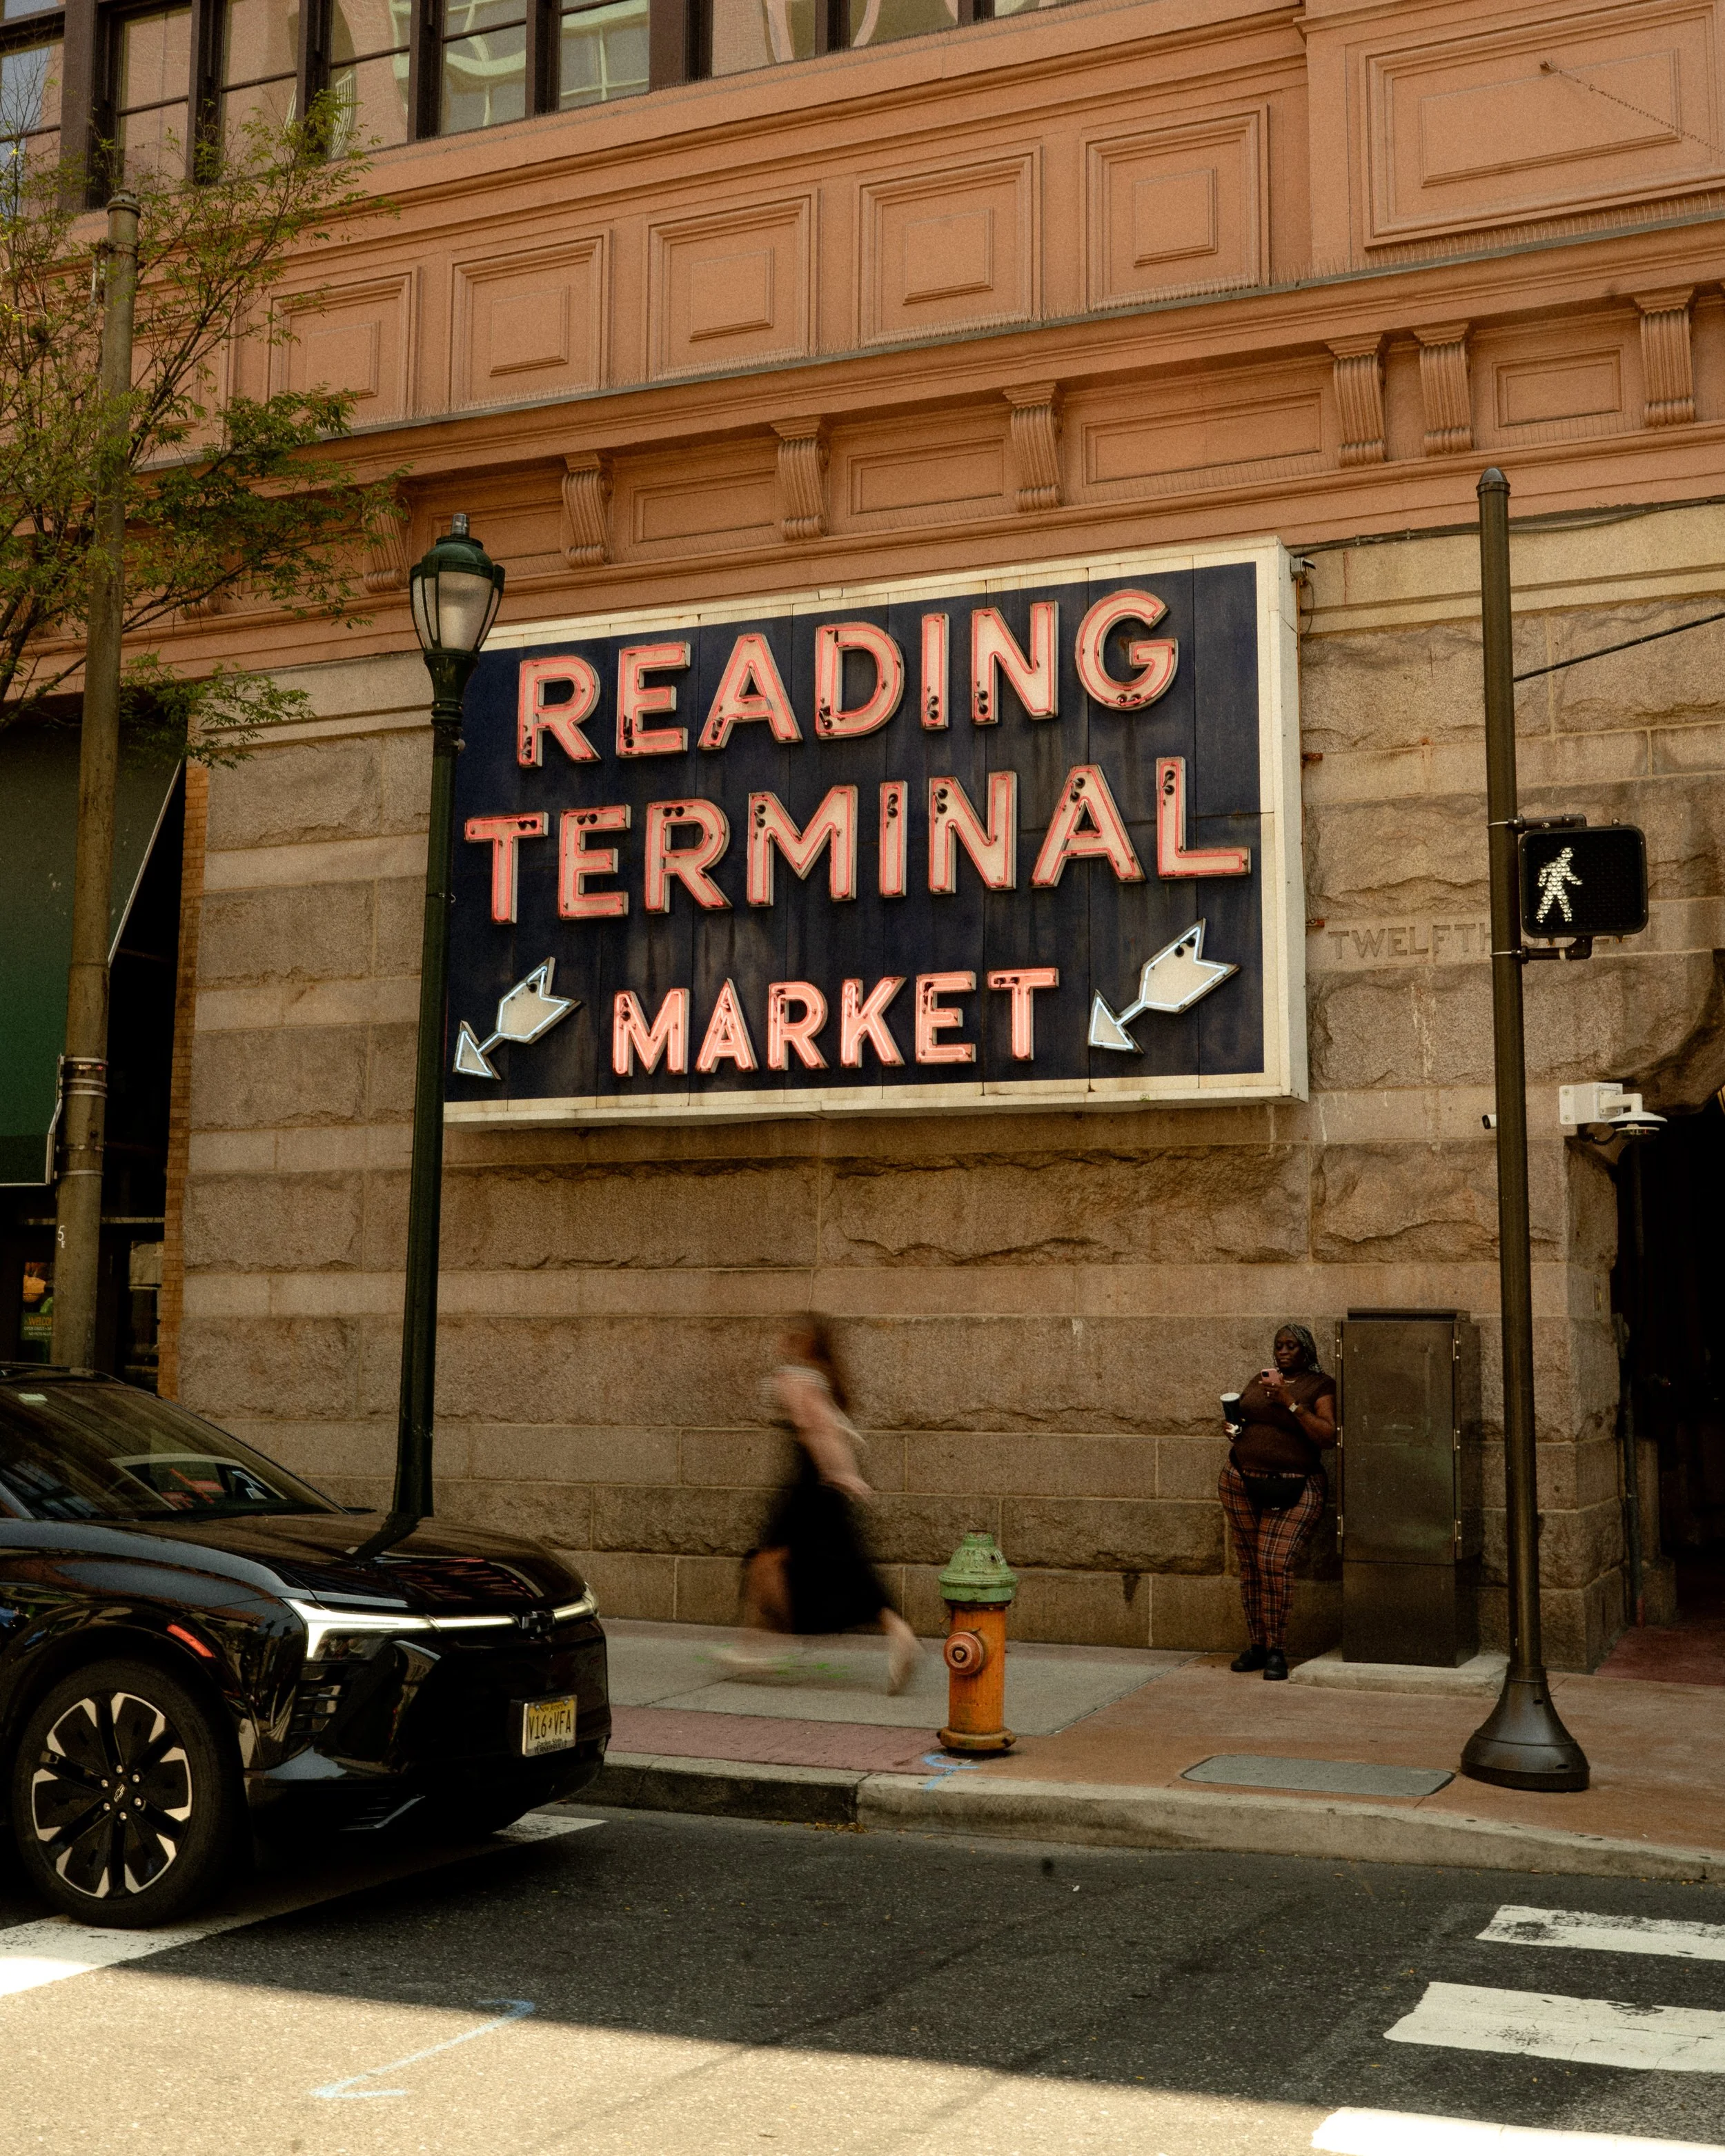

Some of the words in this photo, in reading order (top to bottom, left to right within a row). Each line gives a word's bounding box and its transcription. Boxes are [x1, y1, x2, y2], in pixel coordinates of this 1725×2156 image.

[516, 589, 1179, 768] READING
[465, 757, 1252, 925] TERMINAL
[612, 967, 1060, 1078] MARKET
[28, 1316, 52, 1325] WELCO
